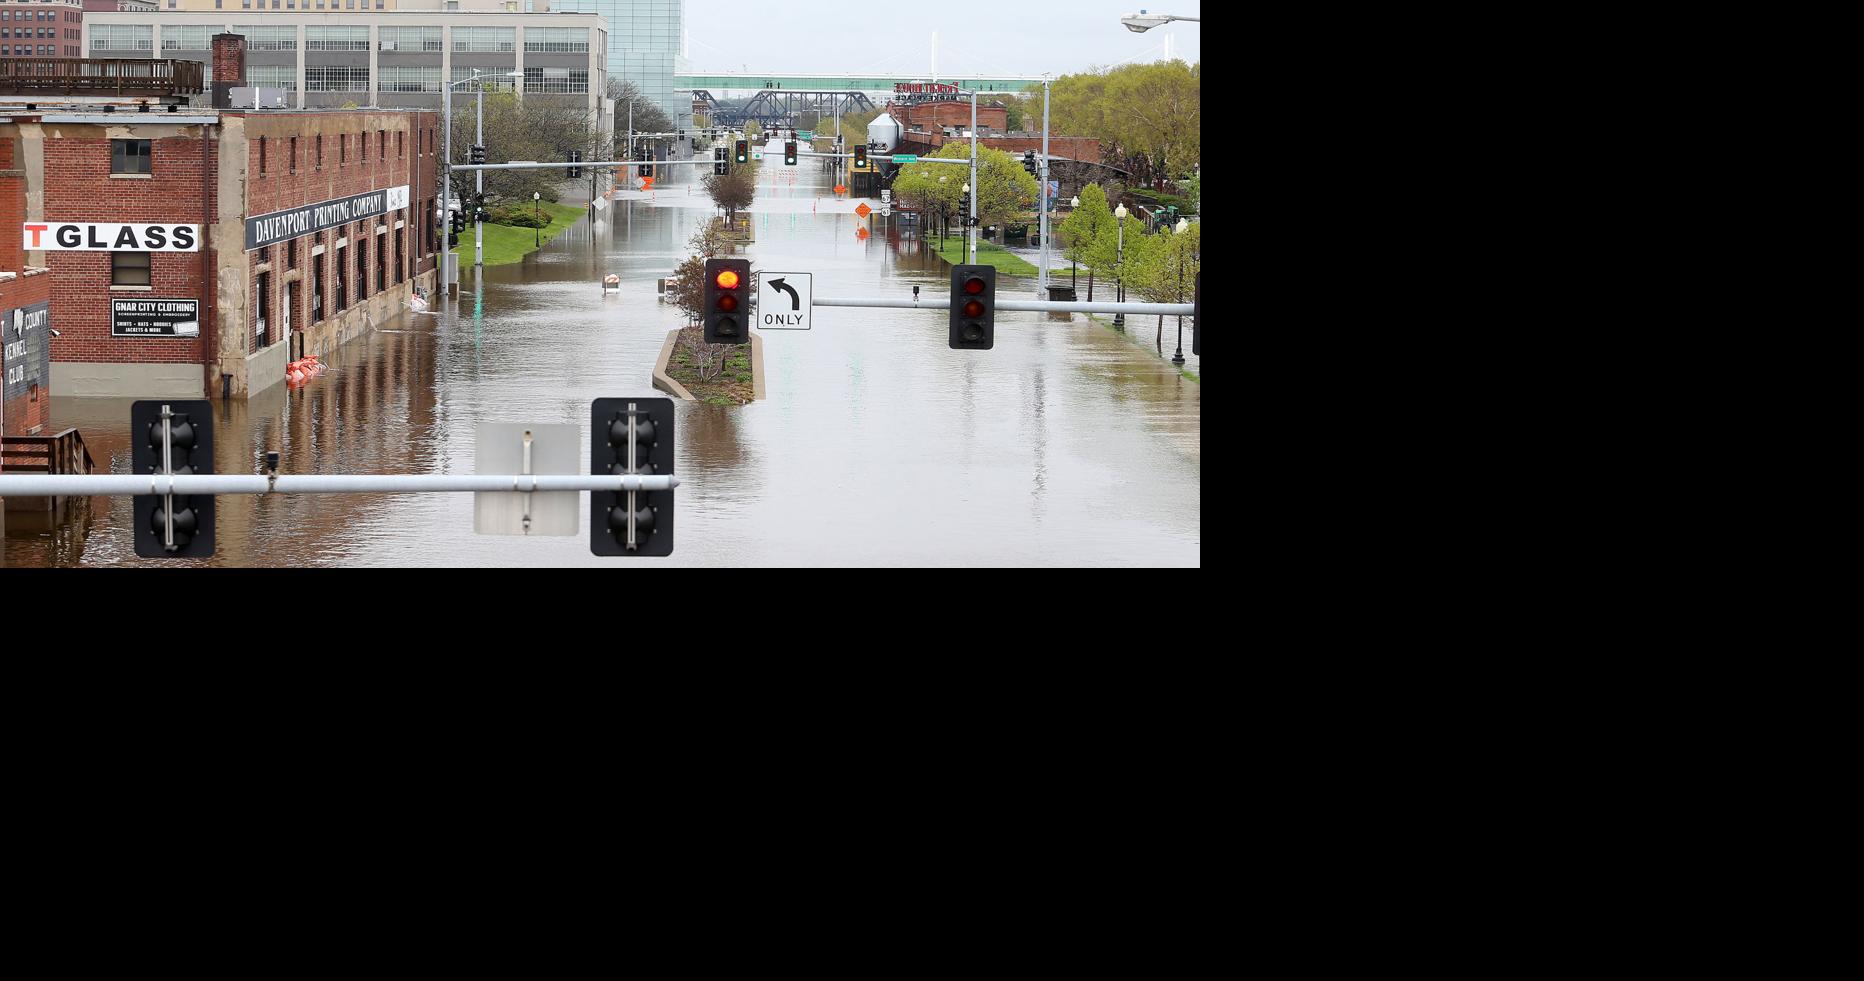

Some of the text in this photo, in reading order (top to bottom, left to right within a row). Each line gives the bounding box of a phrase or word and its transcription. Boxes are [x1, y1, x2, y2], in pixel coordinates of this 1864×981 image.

[255, 210, 310, 243] DAVENPORT
[314, 201, 350, 227] PRINTING
[352, 194, 382, 217] COMPANY
[25, 225, 194, 249] T GLASS
[115, 302, 195, 312] GNAR CITY CLOTHING
[25, 309, 47, 330] COUNTY
[764, 314, 803, 325] ONLY
[5, 340, 27, 360] KENNEL
[9, 364, 24, 384] CLUB
